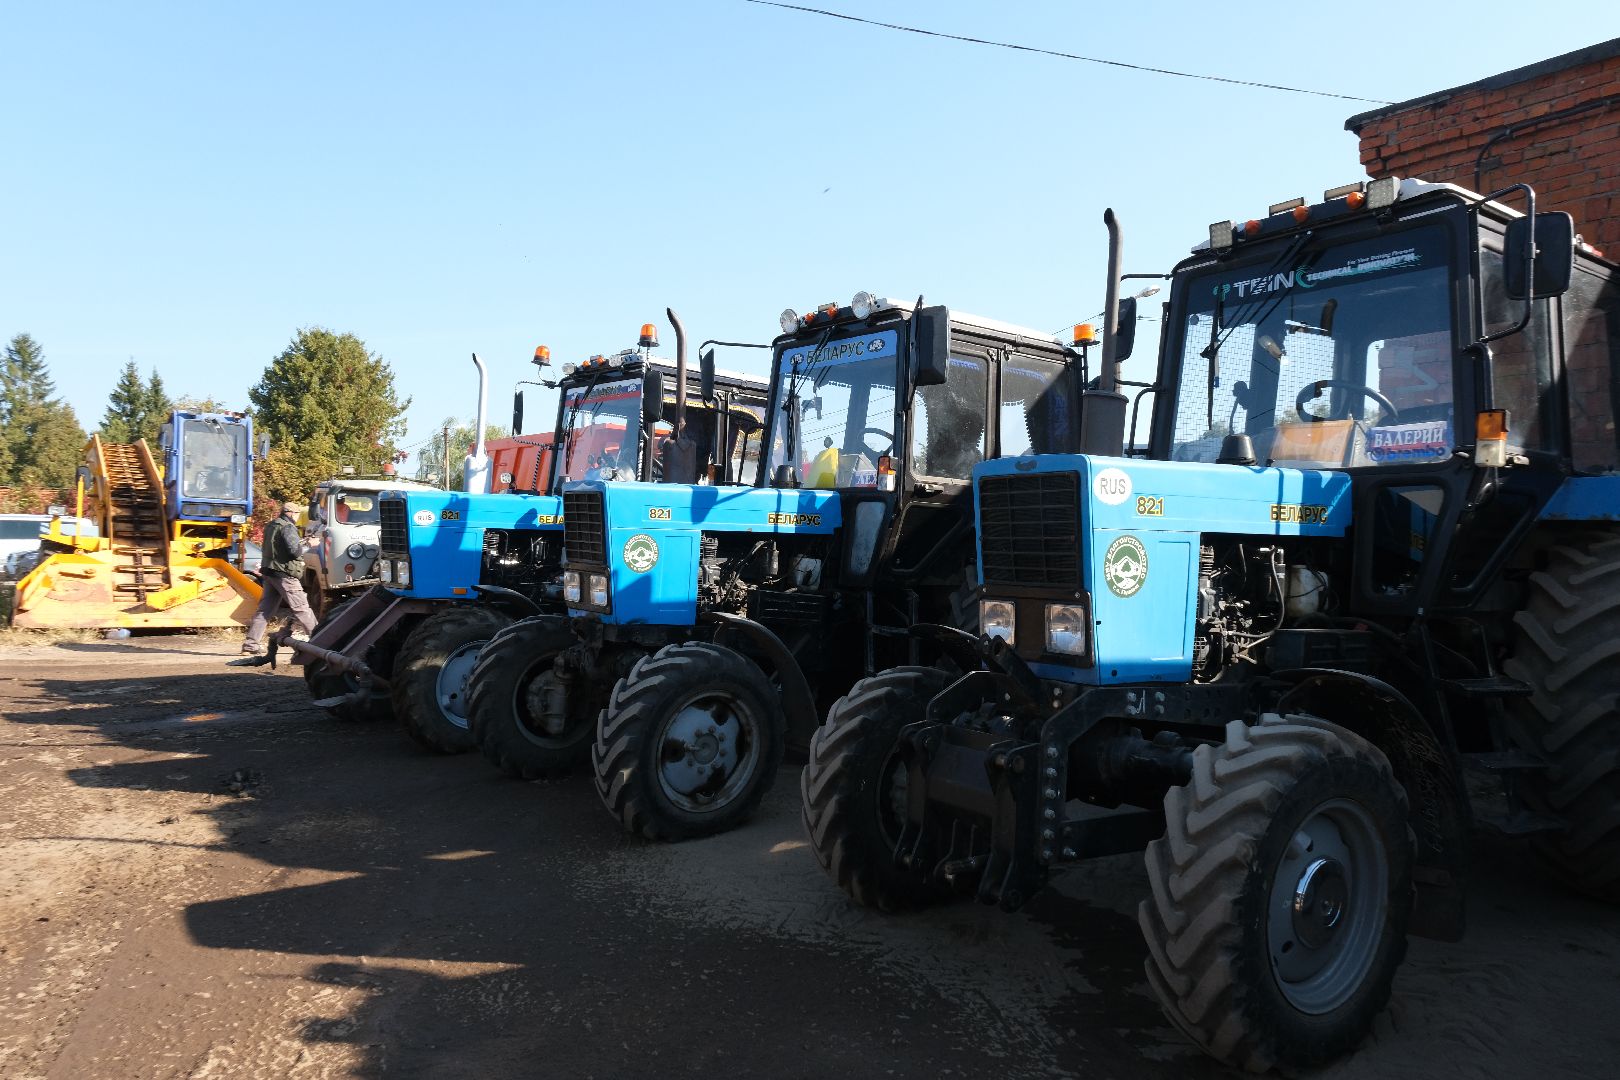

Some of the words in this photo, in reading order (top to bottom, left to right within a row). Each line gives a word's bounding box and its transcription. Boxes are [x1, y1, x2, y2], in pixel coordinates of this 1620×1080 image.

[1100, 477, 1126, 495] RUS
[1136, 496, 1164, 516] 82.1
[1270, 504, 1329, 524] БЕЛАРУС
[768, 512, 821, 526] БЕЛАРУС
